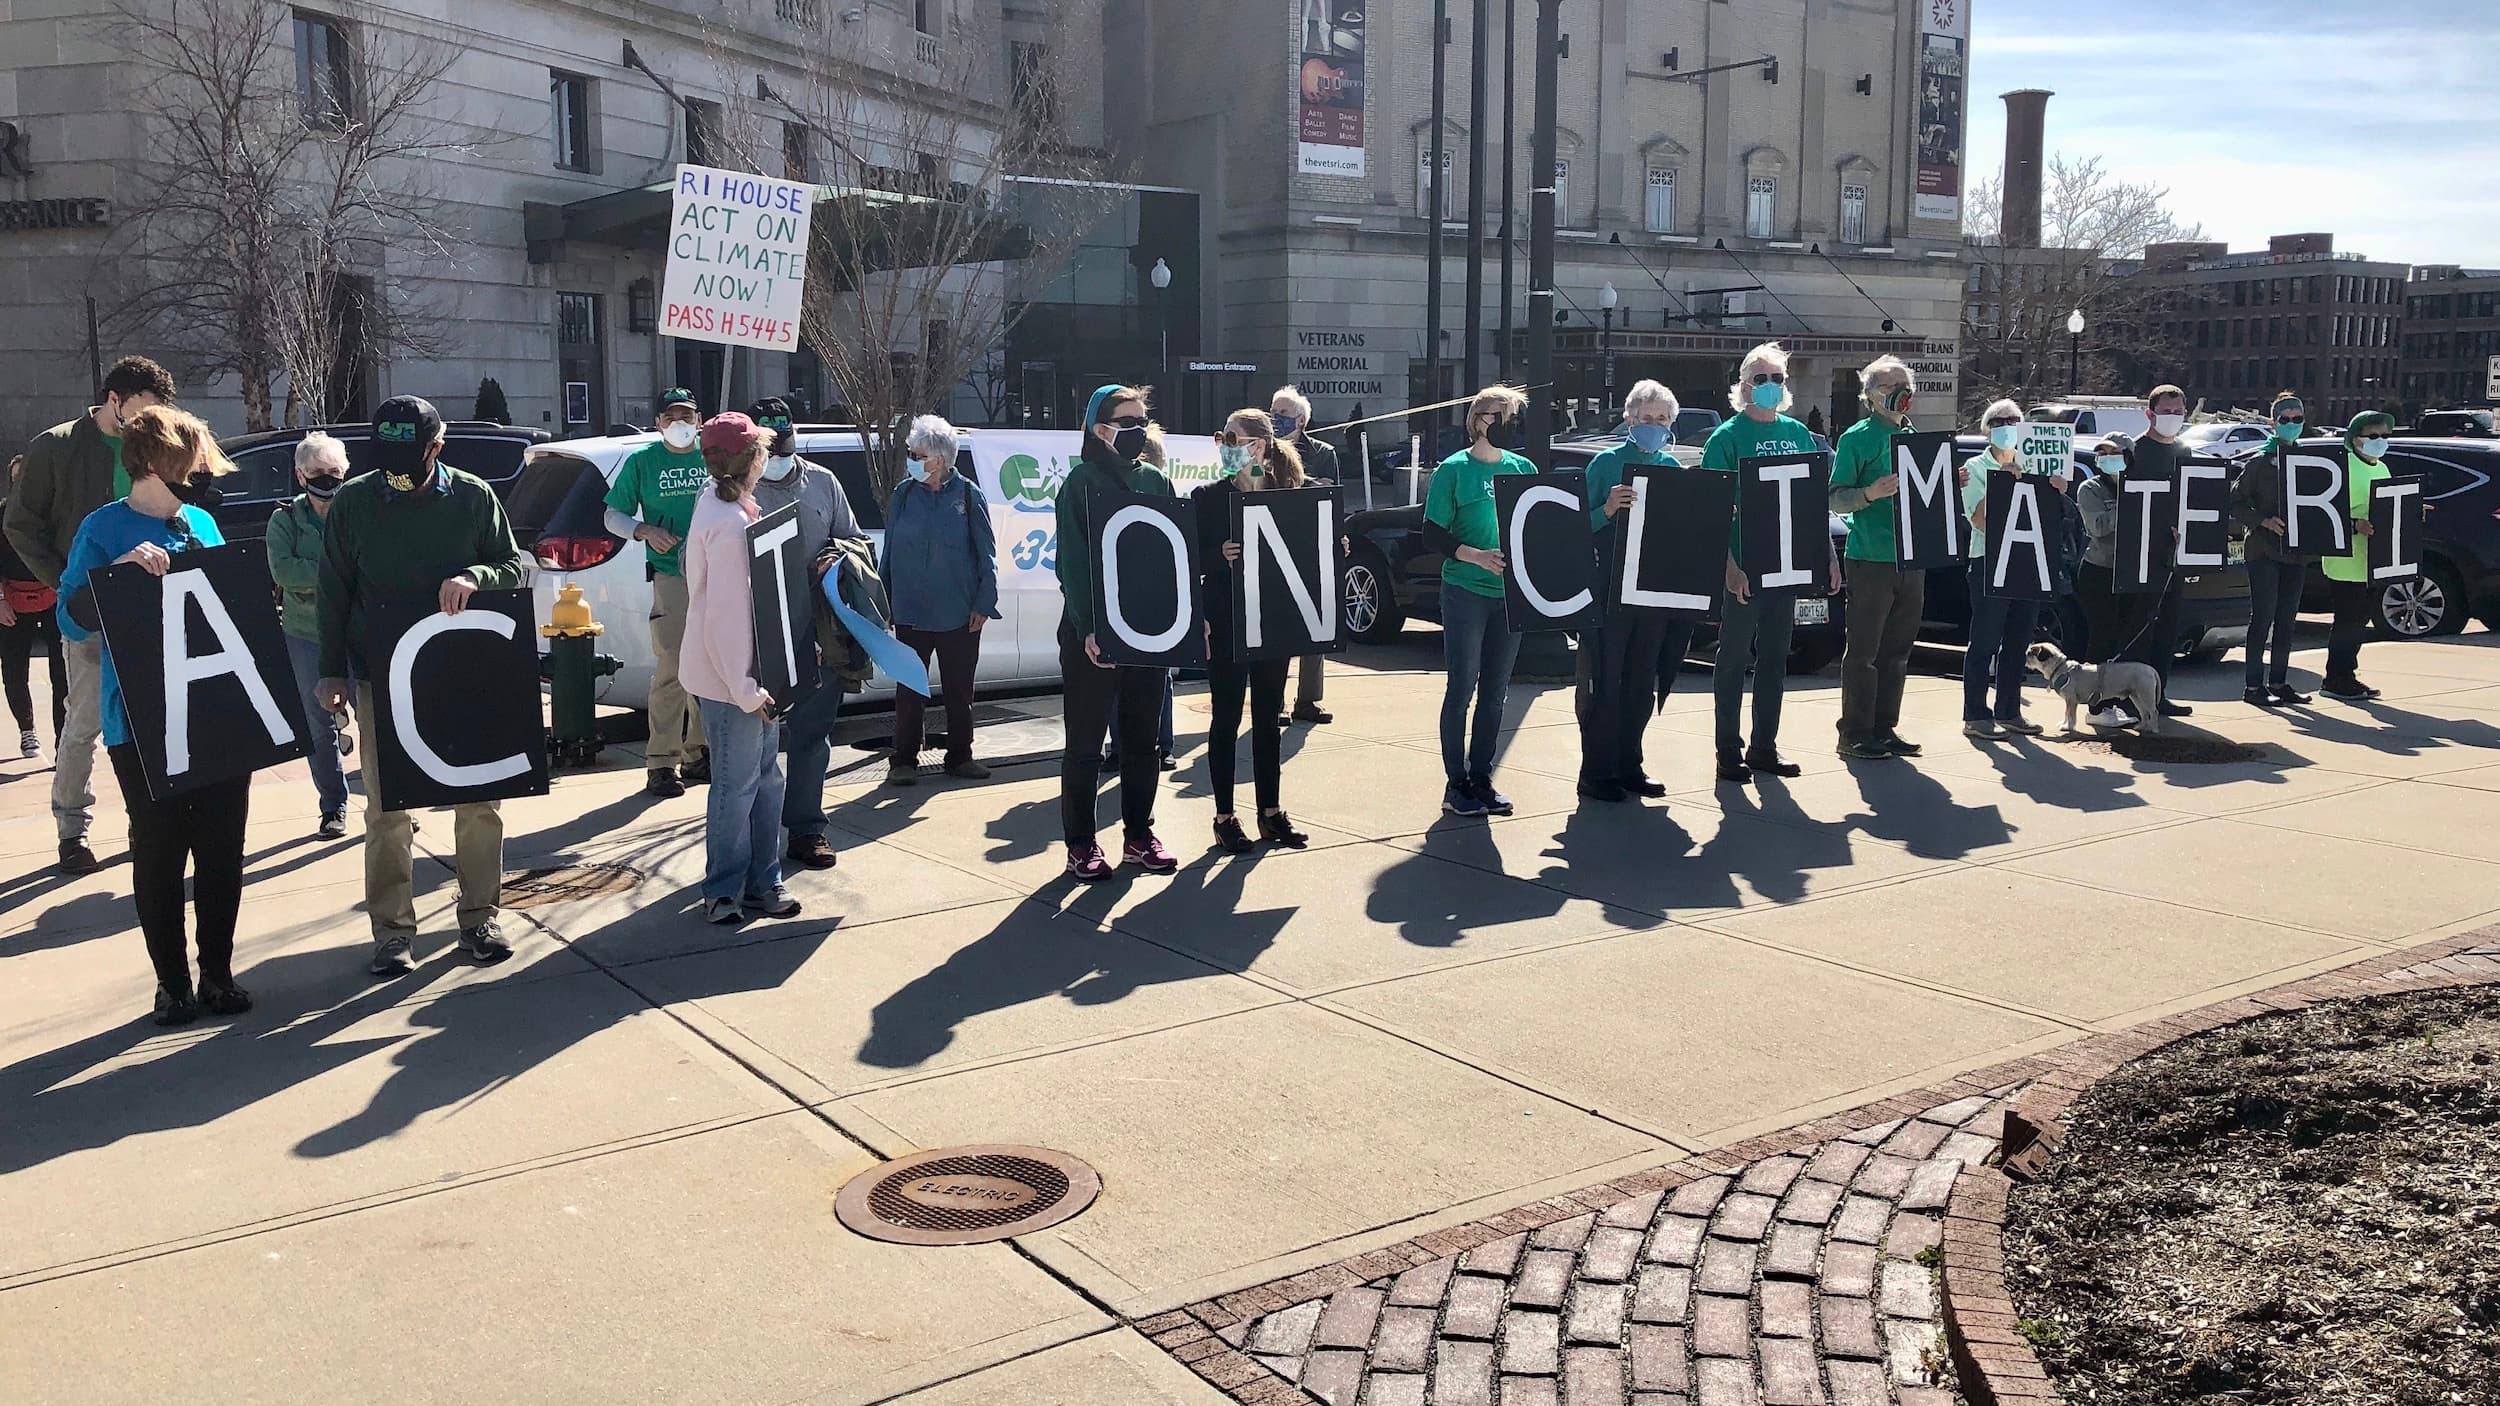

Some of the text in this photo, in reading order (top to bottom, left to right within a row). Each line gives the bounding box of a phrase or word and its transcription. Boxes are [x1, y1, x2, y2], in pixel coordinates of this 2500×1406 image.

[1304, 156, 1360, 170] thevetsri.com
[680, 171, 804, 214] RI HOUSE
[680, 202, 797, 243] ACT ON
[674, 233, 805, 280] CLIMATE
[693, 273, 773, 309] NOW!
[667, 303, 714, 332] PASS
[1298, 332, 1366, 347] VETERANS
[1189, 362, 1257, 372] Ballroom Entrance
[1297, 356, 1369, 371] MEMORIAL
[1907, 362, 1953, 374] MEMORIAL
[1298, 380, 1382, 395] AUDITORIUM
[1915, 381, 1953, 393] ITORIUM
[2032, 425, 2072, 438] TIME TO
[1755, 440, 1798, 452] ACT ON
[2022, 437, 2069, 456] GREEN
[659, 467, 708, 480] ACT ON
[2037, 457, 2064, 477] UP!
[917, 1182, 1020, 1201] ELECTRIC
